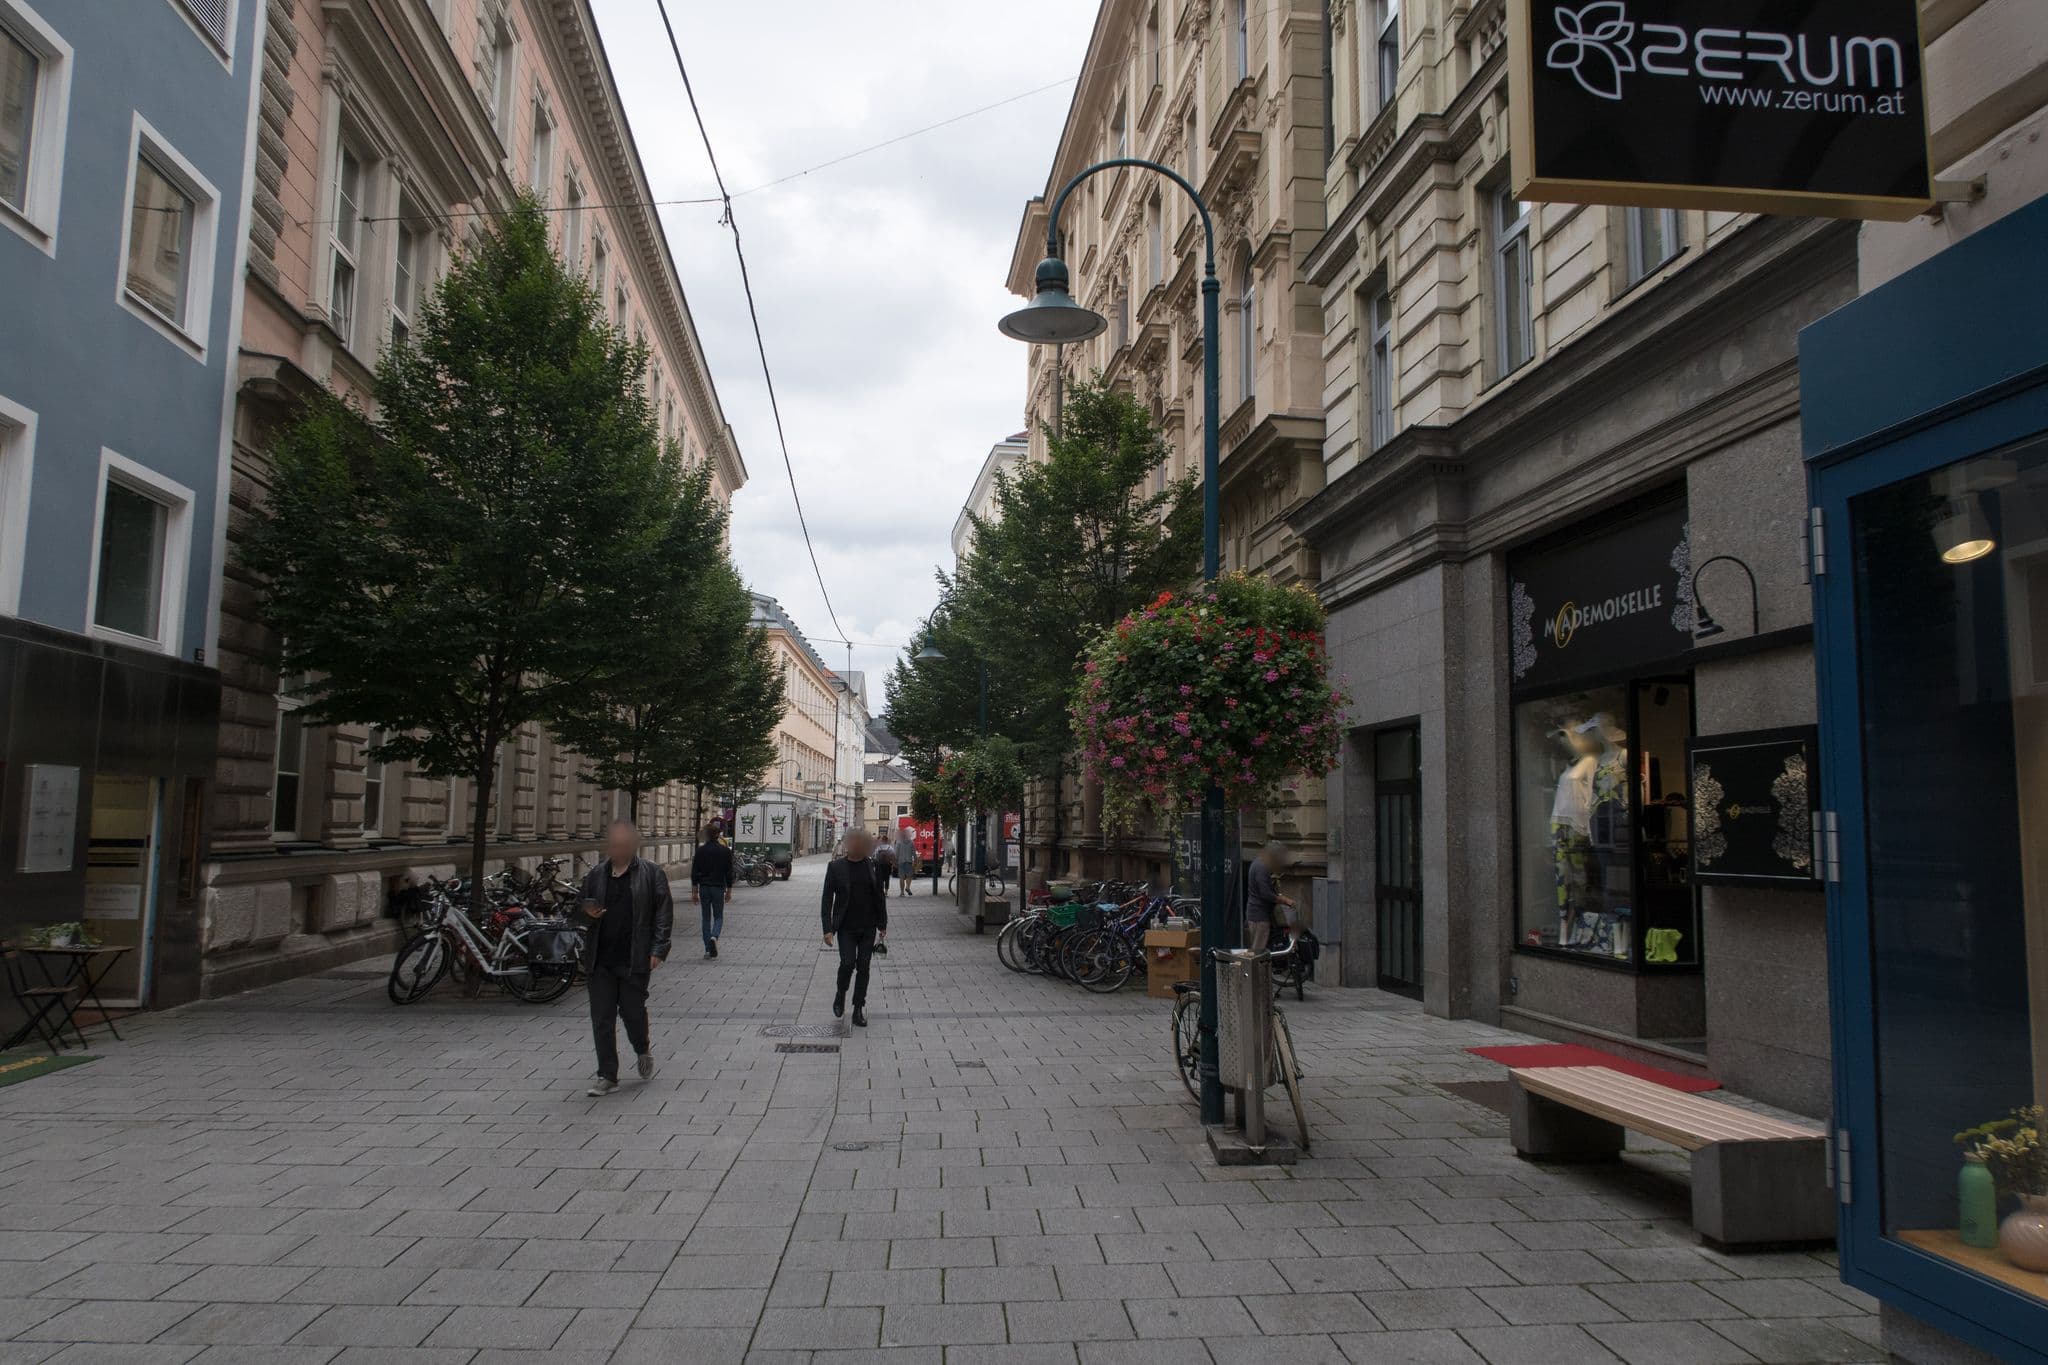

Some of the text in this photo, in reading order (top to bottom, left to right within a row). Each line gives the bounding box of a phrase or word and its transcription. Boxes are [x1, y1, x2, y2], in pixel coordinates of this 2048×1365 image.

[1640, 23, 1904, 88] ZERUM
[1698, 84, 1905, 115] www.zerum.at
[1543, 583, 1663, 640] MADEMOISELLE
[742, 824, 754, 835] R
[773, 825, 785, 836] R
